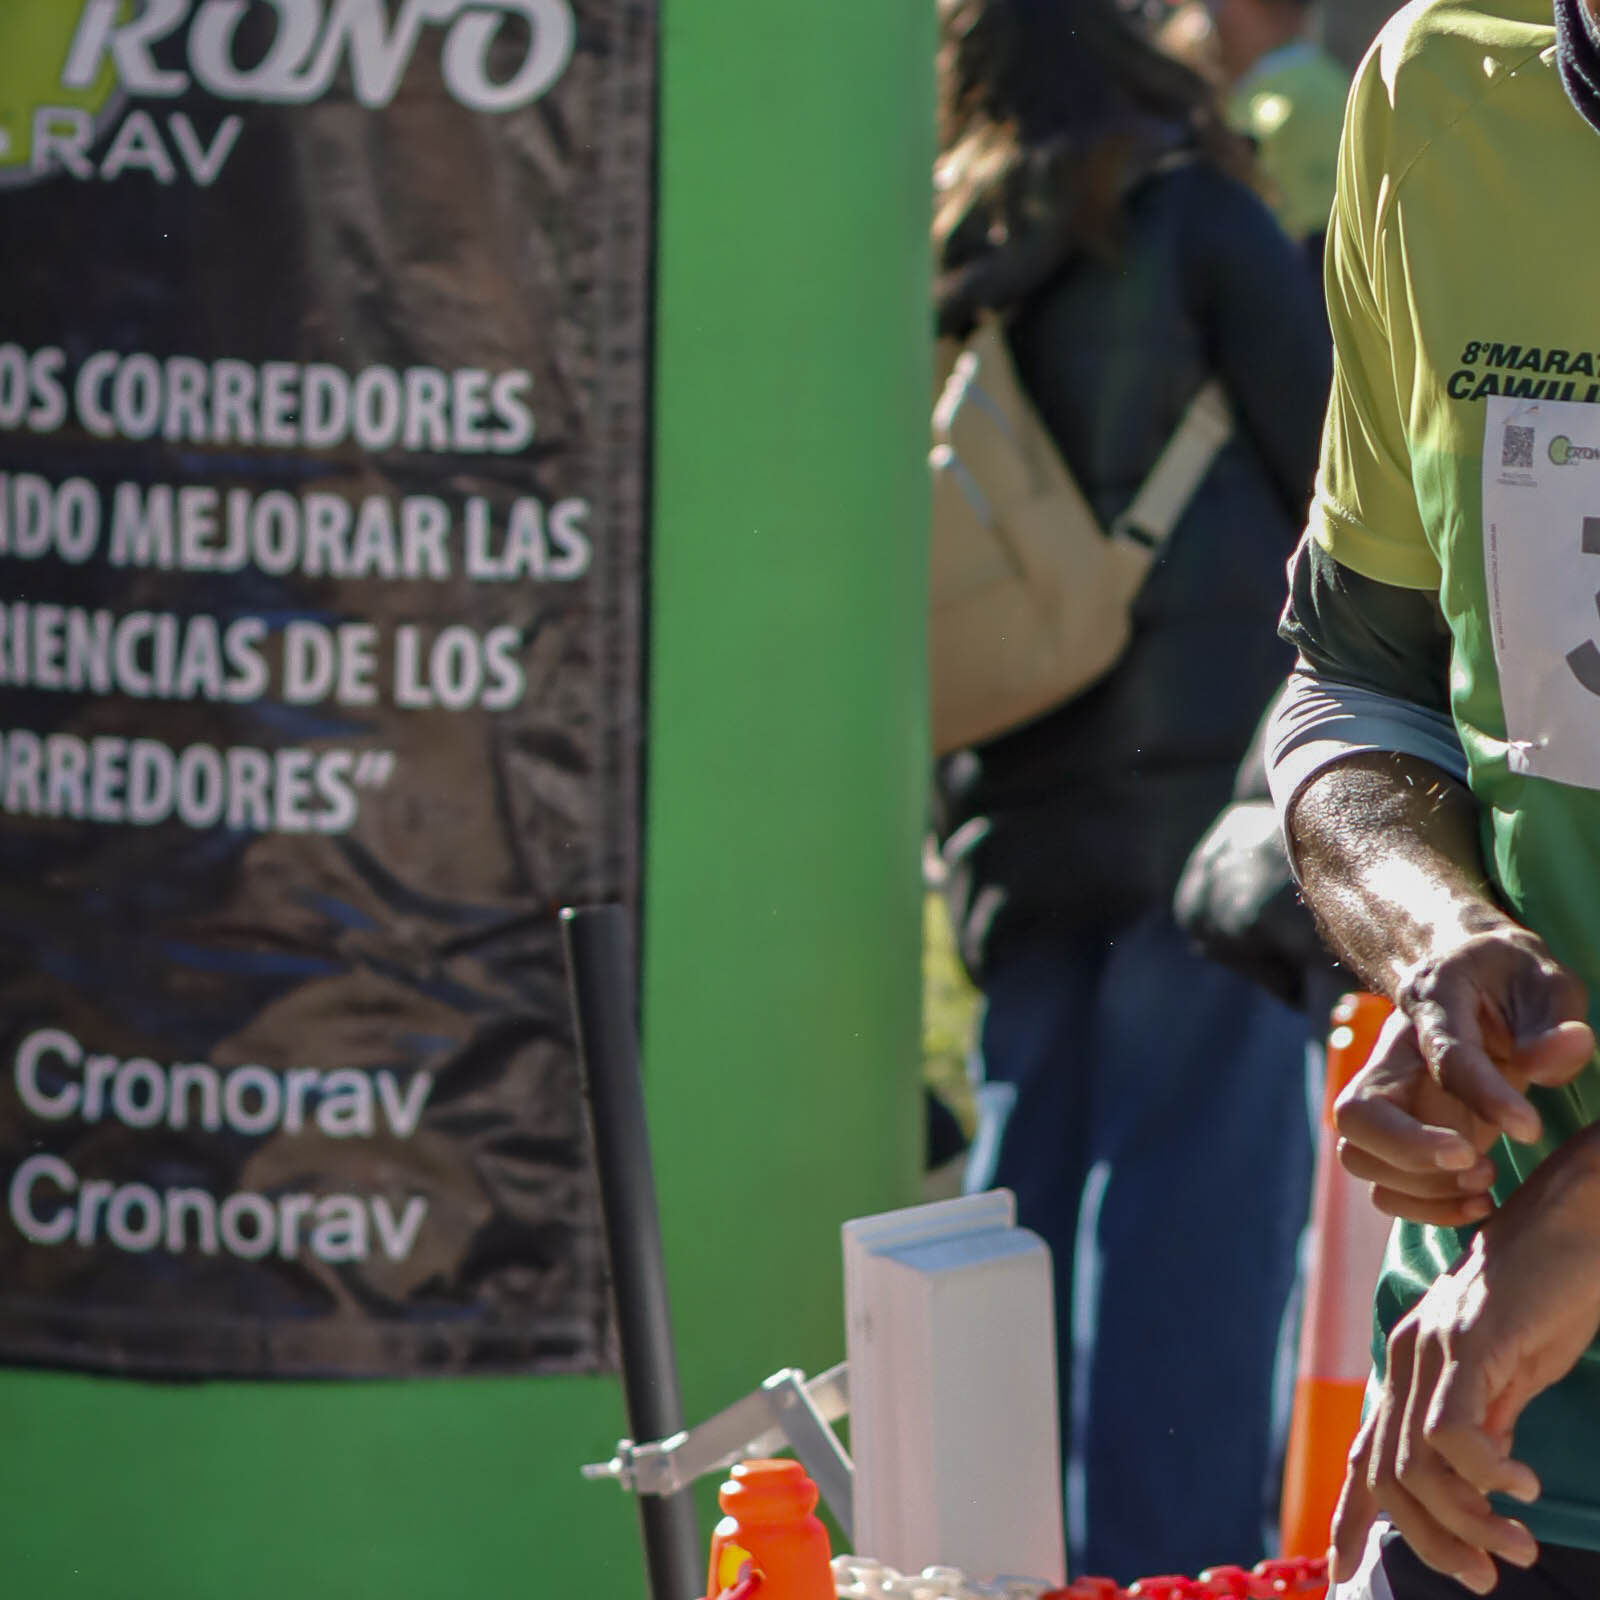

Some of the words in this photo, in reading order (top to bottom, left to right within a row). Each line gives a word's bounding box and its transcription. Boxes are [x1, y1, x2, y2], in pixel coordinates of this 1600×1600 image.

[75, 351, 534, 454] CORREDORES
[110, 481, 451, 581] MEJORAR
[466, 497, 592, 582] LAS
[284, 621, 376, 706] DE
[396, 625, 525, 710] LOS
[14, 1027, 432, 1138] Cronorav
[8, 1154, 426, 1261] Cronorav
